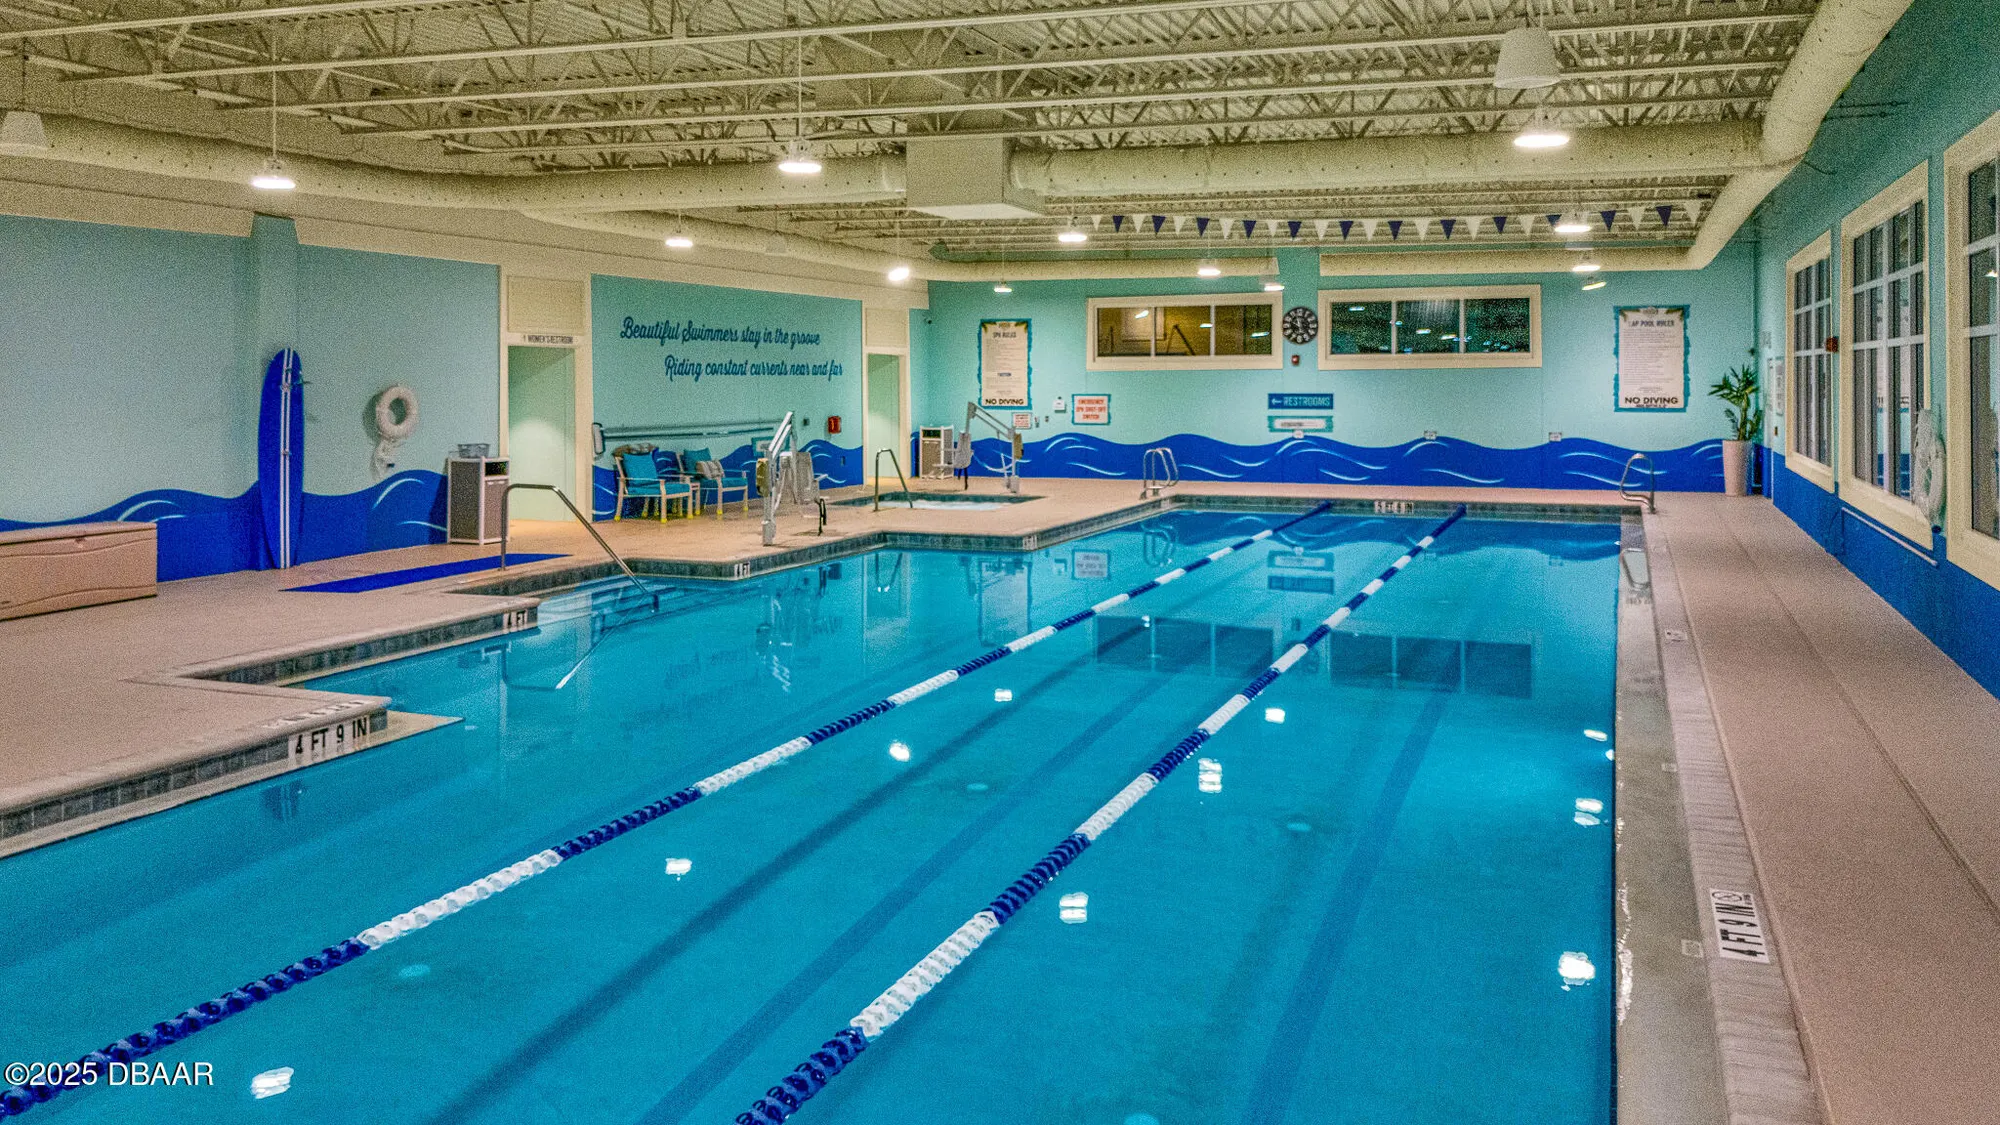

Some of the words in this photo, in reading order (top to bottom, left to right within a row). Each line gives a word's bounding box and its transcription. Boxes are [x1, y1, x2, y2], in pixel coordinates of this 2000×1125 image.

[620, 316, 680, 347] Beautiful
[682, 320, 738, 344] Swimmers
[741, 326, 760, 349] stay
[763, 327, 772, 344] in
[775, 328, 788, 344] the
[790, 332, 821, 350] groove
[665, 354, 702, 382] Riding
[705, 359, 749, 376] constant
[750, 360, 787, 376] currents
[790, 362, 810, 376] near
[812, 361, 828, 376] and
[827, 360, 843, 382] far
[1283, 396, 1331, 407] RESTROOMS
[1624, 397, 1640, 405] NO
[1643, 397, 1679, 405] DIVING
[516, 610, 527, 627] FT
[295, 733, 304, 754] 4
[311, 727, 329, 751] FT
[336, 723, 345, 743] 9
[352, 717, 367, 739] IN
[1715, 903, 1755, 917] IN
[1718, 919, 1757, 927] 9
[1720, 929, 1762, 946] FT
[1722, 947, 1765, 957] 4
